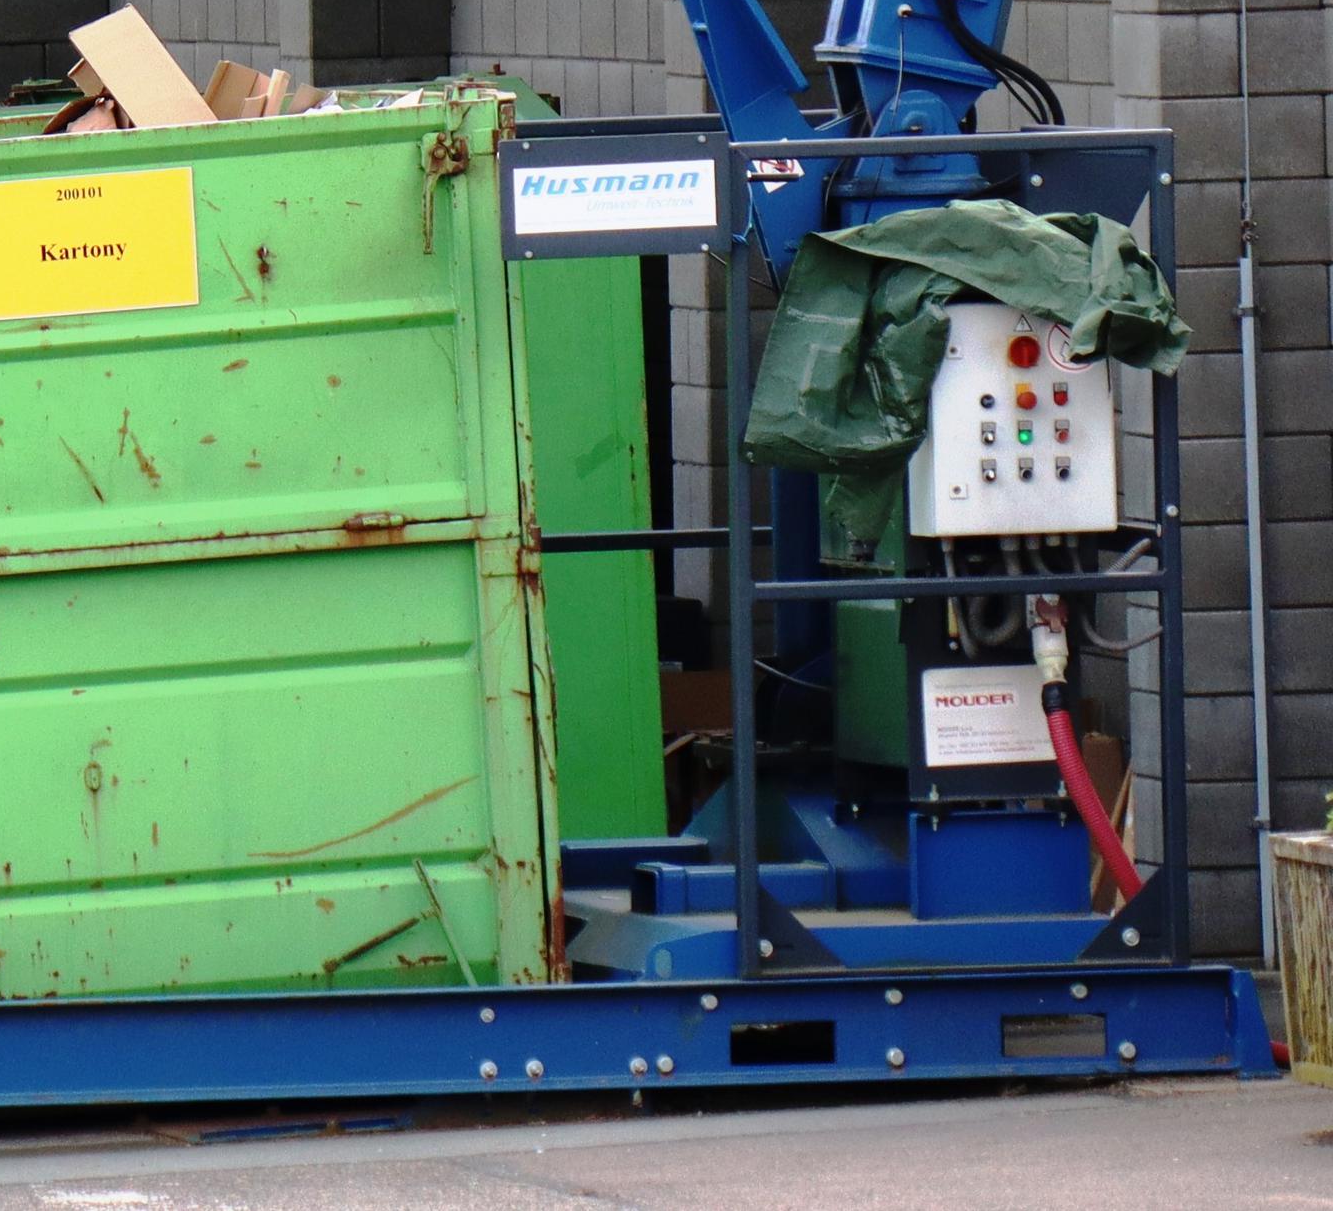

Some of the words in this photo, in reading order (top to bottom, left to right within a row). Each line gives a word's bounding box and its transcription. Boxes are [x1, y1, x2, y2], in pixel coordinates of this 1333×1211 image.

[521, 171, 700, 197] Husmann
[56, 186, 103, 202] 200101
[39, 242, 128, 263] Kartony
[935, 692, 1014, 708] MOUDER
